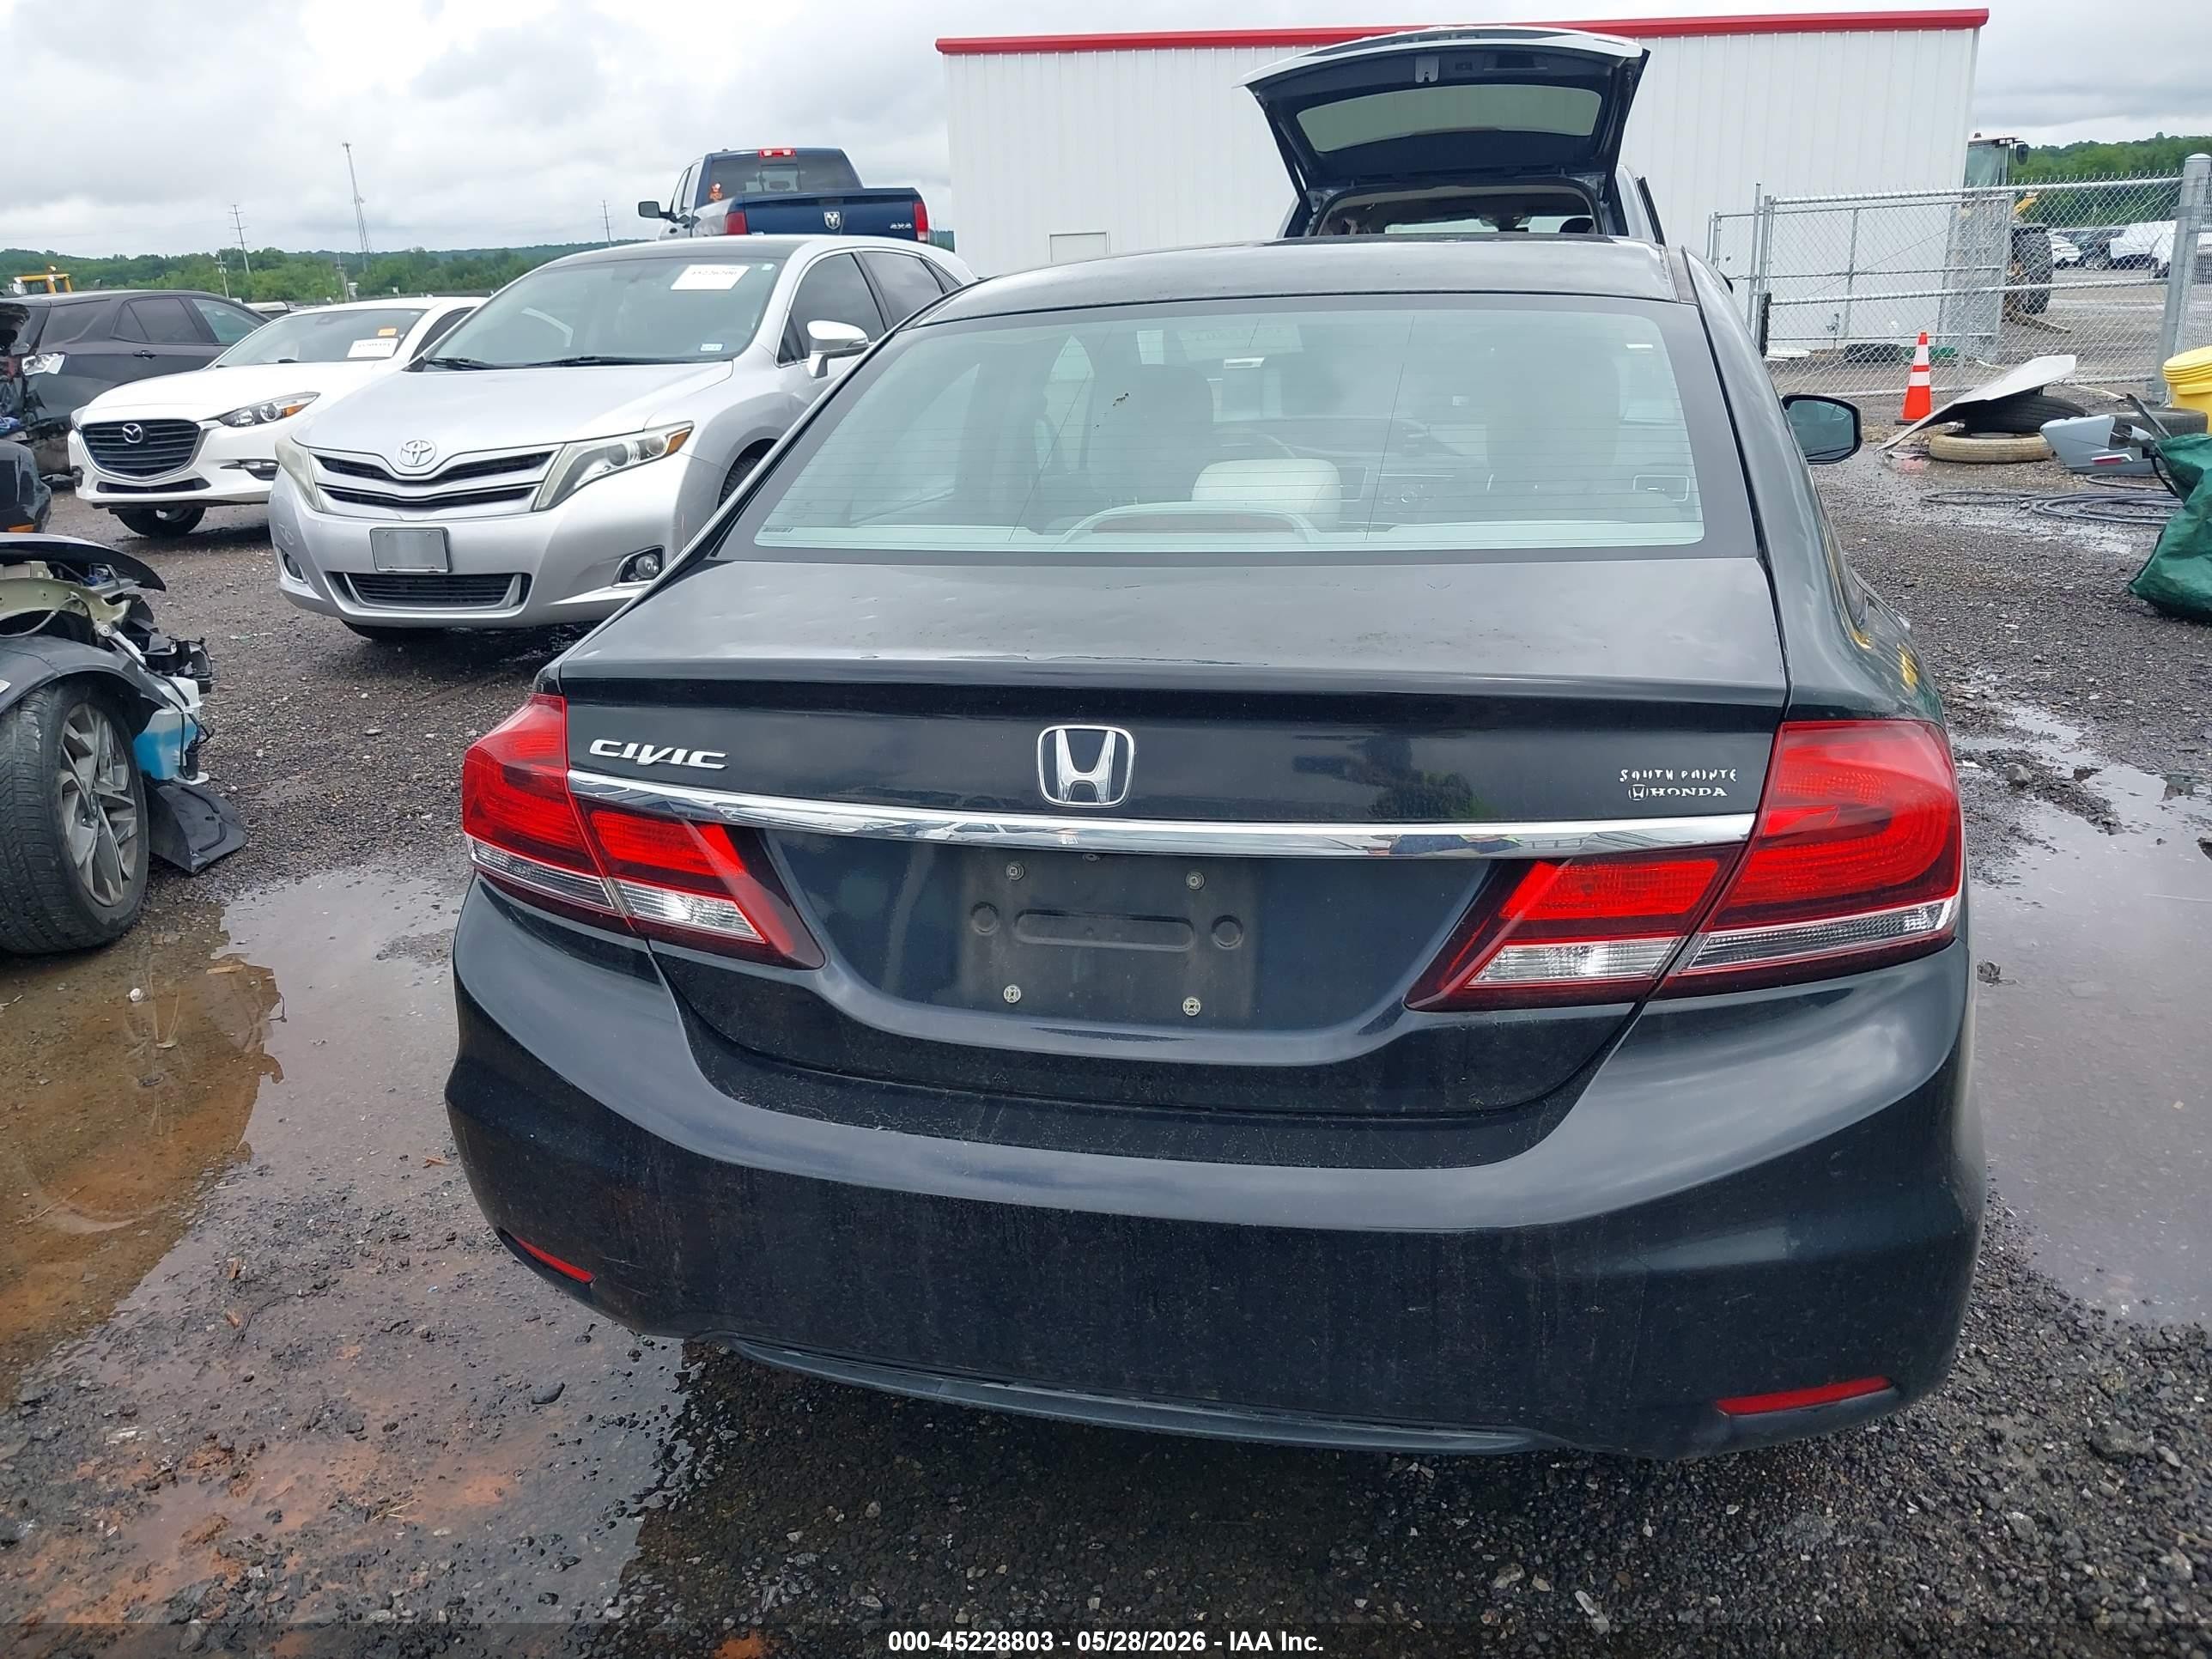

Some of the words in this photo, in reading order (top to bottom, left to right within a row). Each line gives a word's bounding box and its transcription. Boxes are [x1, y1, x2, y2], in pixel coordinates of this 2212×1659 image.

[589, 738, 728, 770] CIVIC
[1619, 768, 1674, 782] SOUTH
[1680, 768, 1737, 782] POINTE
[1649, 786, 1728, 798] HONDA
